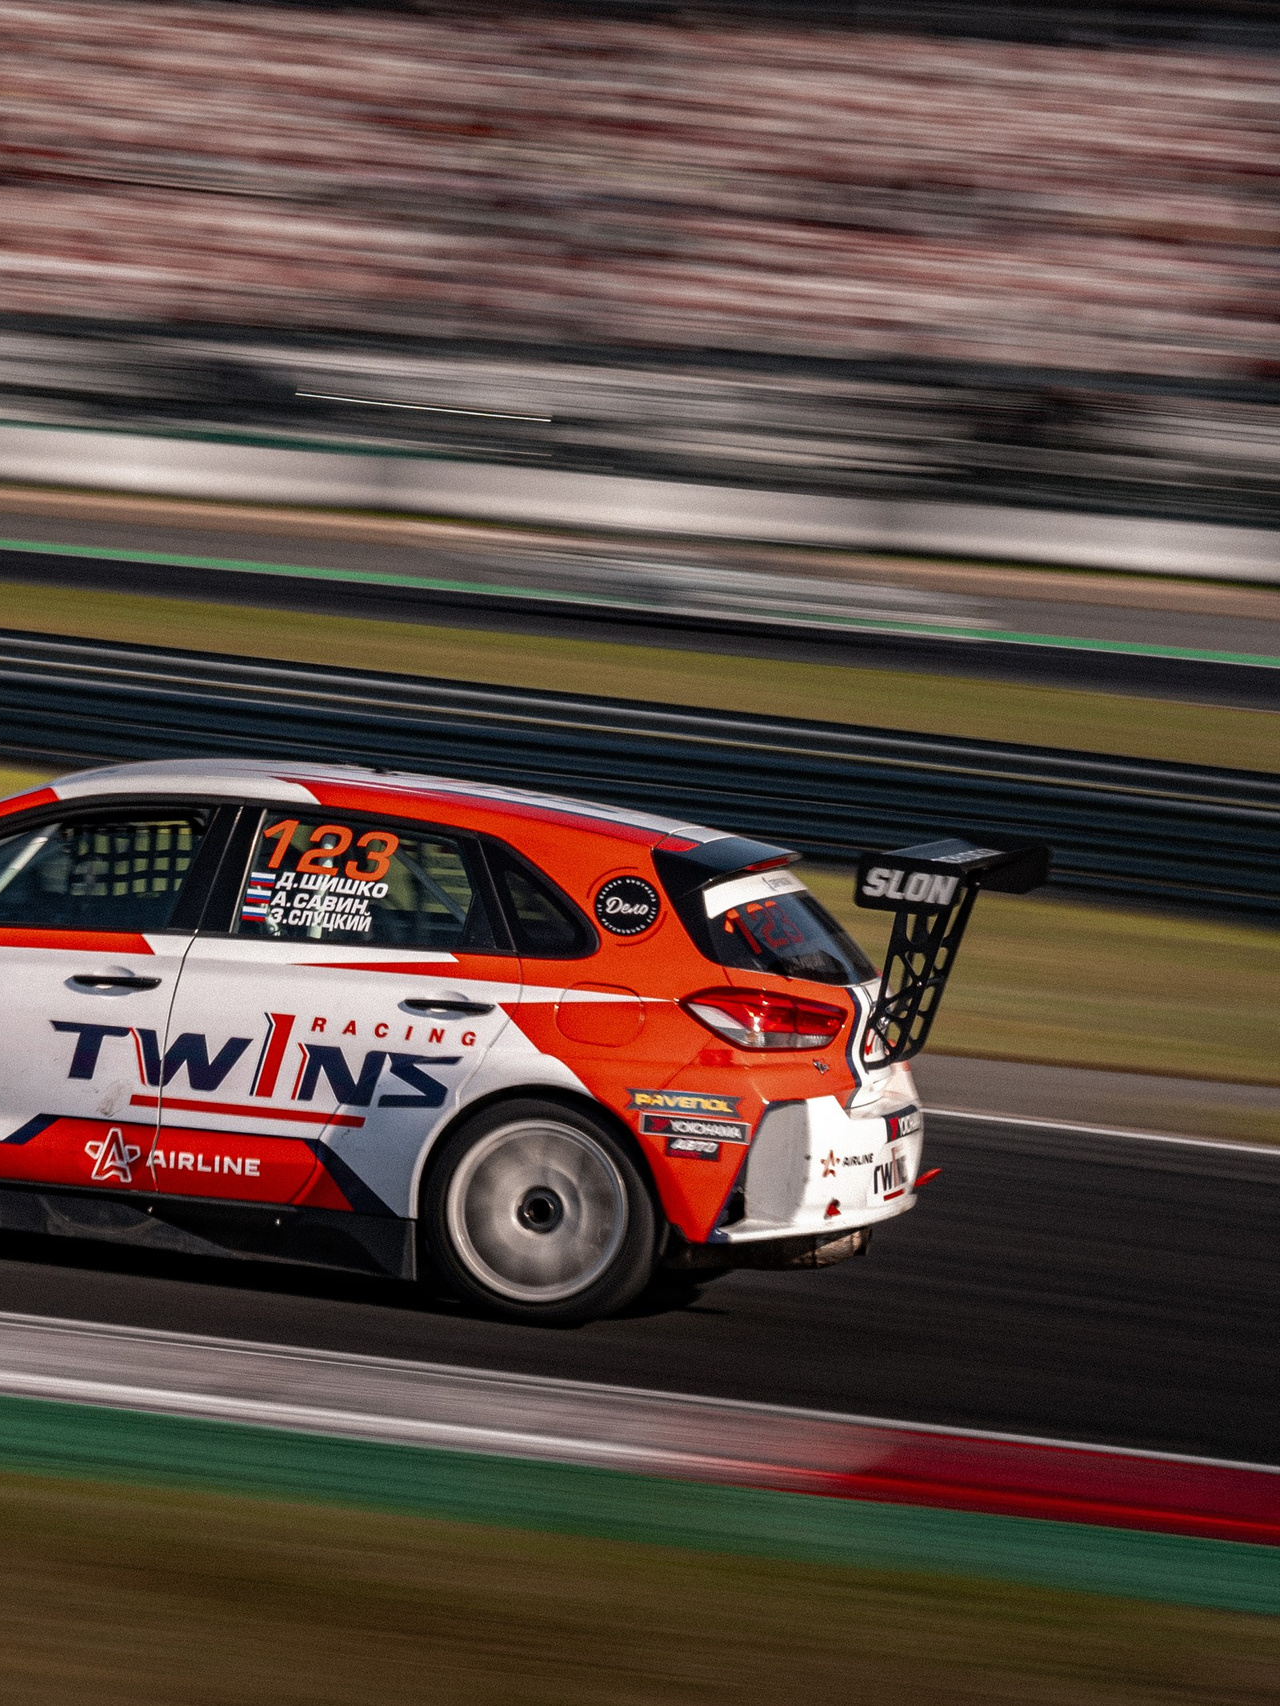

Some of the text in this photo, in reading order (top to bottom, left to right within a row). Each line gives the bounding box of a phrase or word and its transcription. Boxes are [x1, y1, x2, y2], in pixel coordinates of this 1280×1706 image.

[263, 819, 399, 882] 123
[275, 872, 389, 898] Д.ШИШКО
[862, 867, 959, 906] SLON
[271, 891, 369, 914] А.САВИН
[311, 1016, 477, 1047] RACING
[49, 1012, 463, 1109] TWINS
[145, 1149, 261, 1177] AIRLINE
